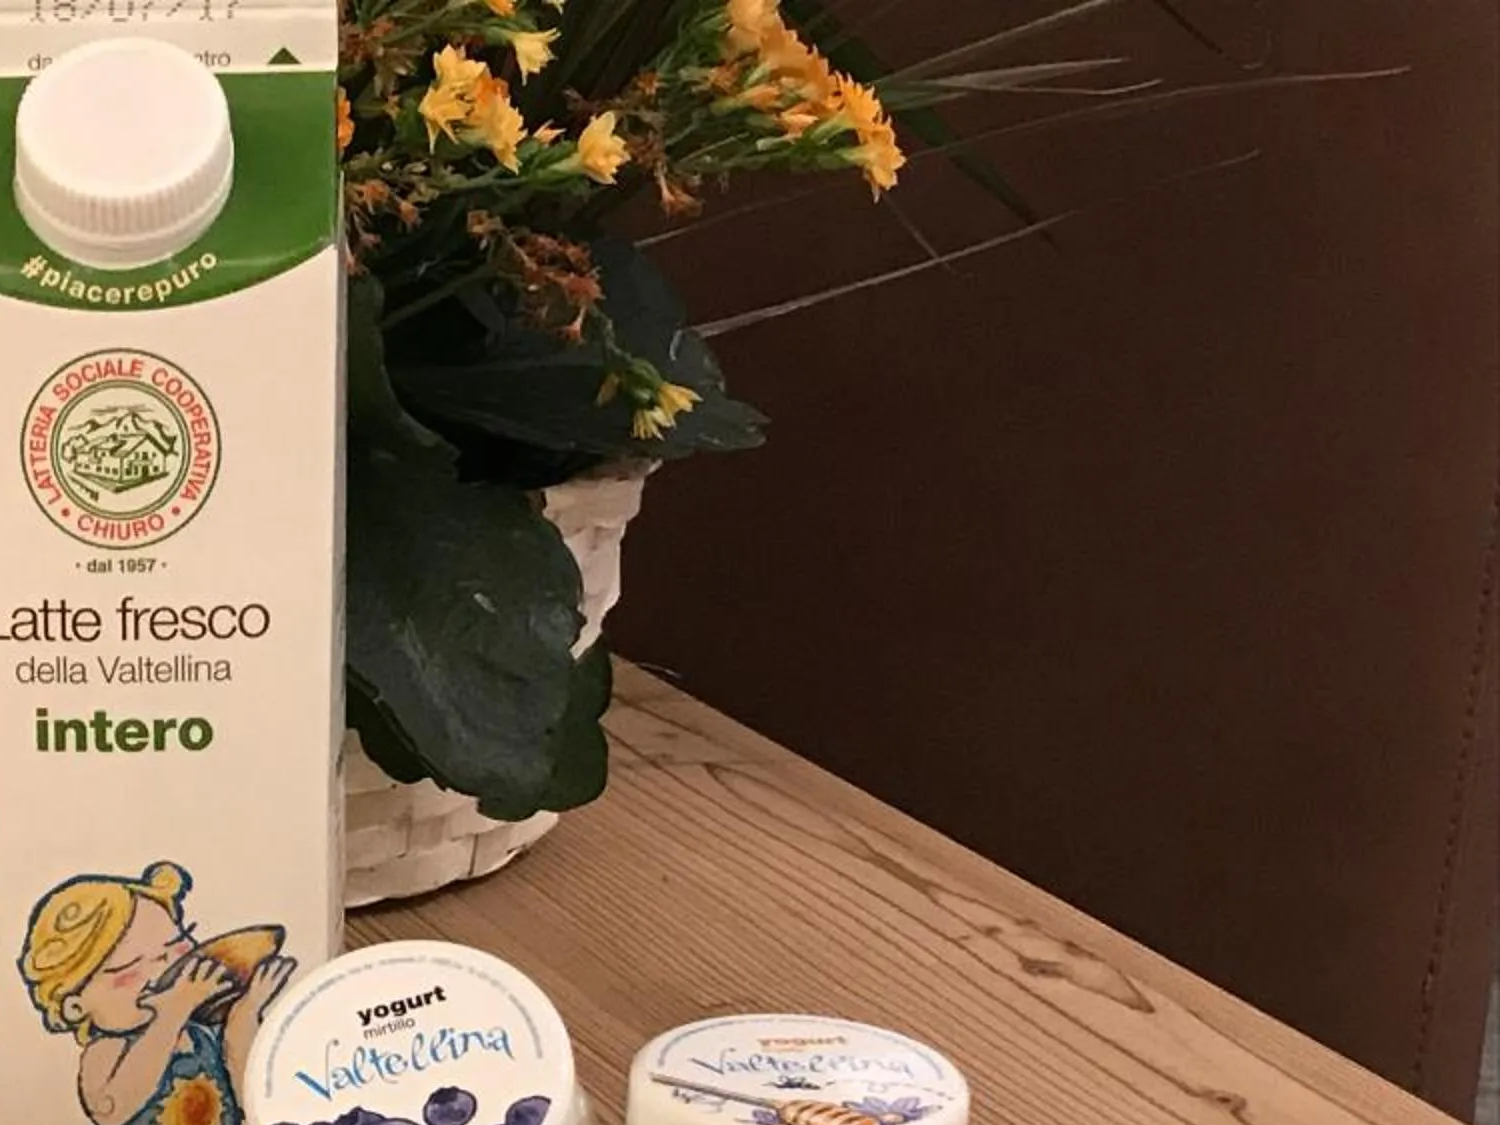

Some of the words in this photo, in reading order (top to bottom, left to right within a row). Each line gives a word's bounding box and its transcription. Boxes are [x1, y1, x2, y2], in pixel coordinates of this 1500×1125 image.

[20, 252, 218, 305] #piacerepuro
[29, 404, 63, 505] LATTERIA
[51, 358, 145, 402] SOCIALE
[150, 366, 213, 502] COOPERATIVA
[76, 513, 165, 541] CHIURO
[86, 558, 112, 574] dal
[118, 558, 157, 574] 1957
[116, 595, 272, 641] fresco
[15, 656, 88, 685] della
[96, 654, 233, 684] Valtellina
[35, 708, 214, 754] intero
[356, 985, 447, 1026] yogurt
[362, 1016, 416, 1041] mirtillo
[295, 1026, 517, 1101] Valtellina
